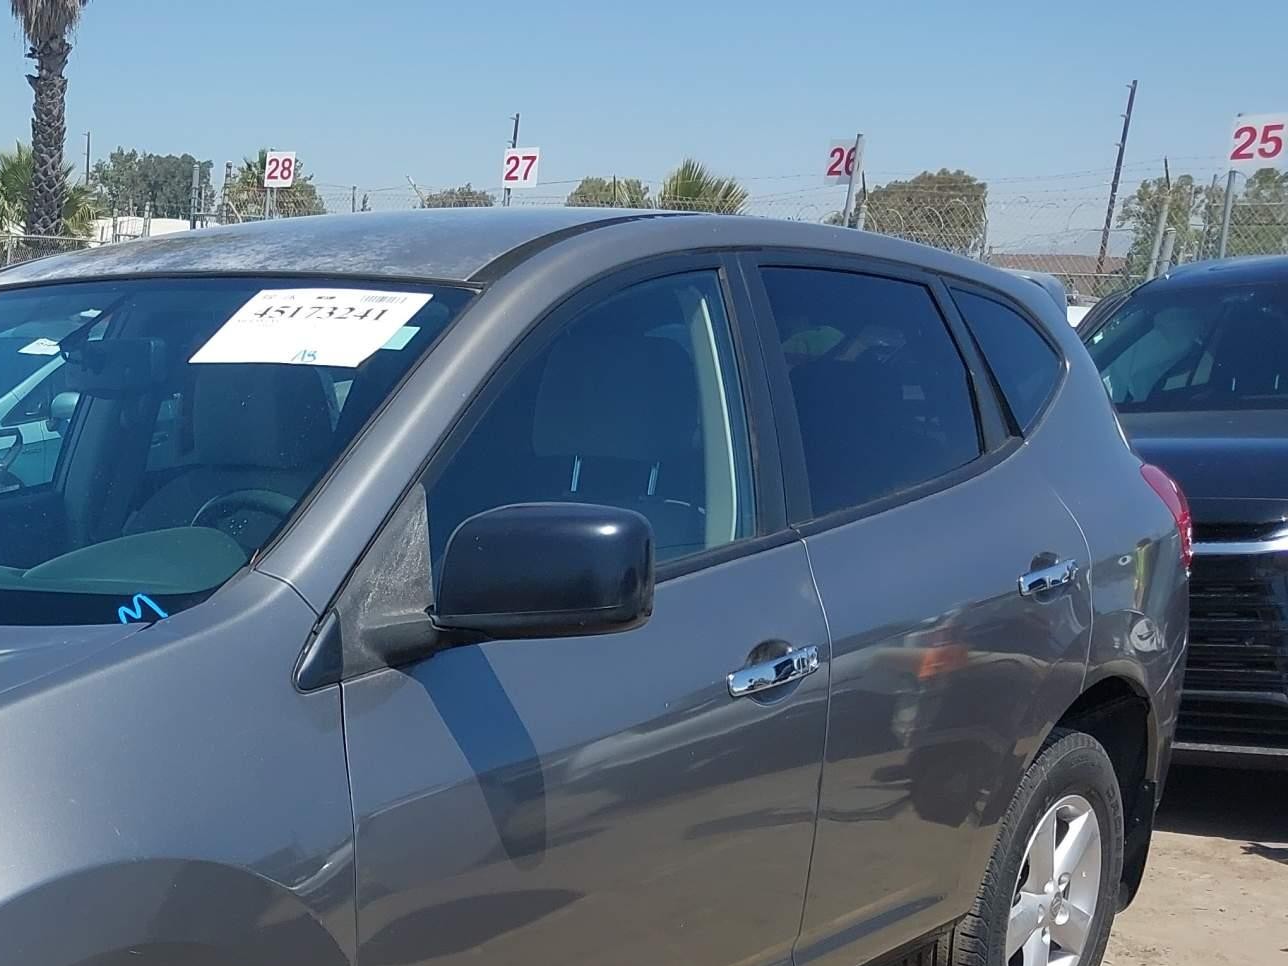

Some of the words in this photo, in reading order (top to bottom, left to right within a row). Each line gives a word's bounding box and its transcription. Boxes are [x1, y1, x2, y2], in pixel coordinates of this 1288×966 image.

[1229, 123, 1285, 160] 25
[266, 157, 293, 181] 28
[504, 154, 538, 182] 27
[826, 147, 857, 177] 26
[253, 304, 389, 321] 45173241
